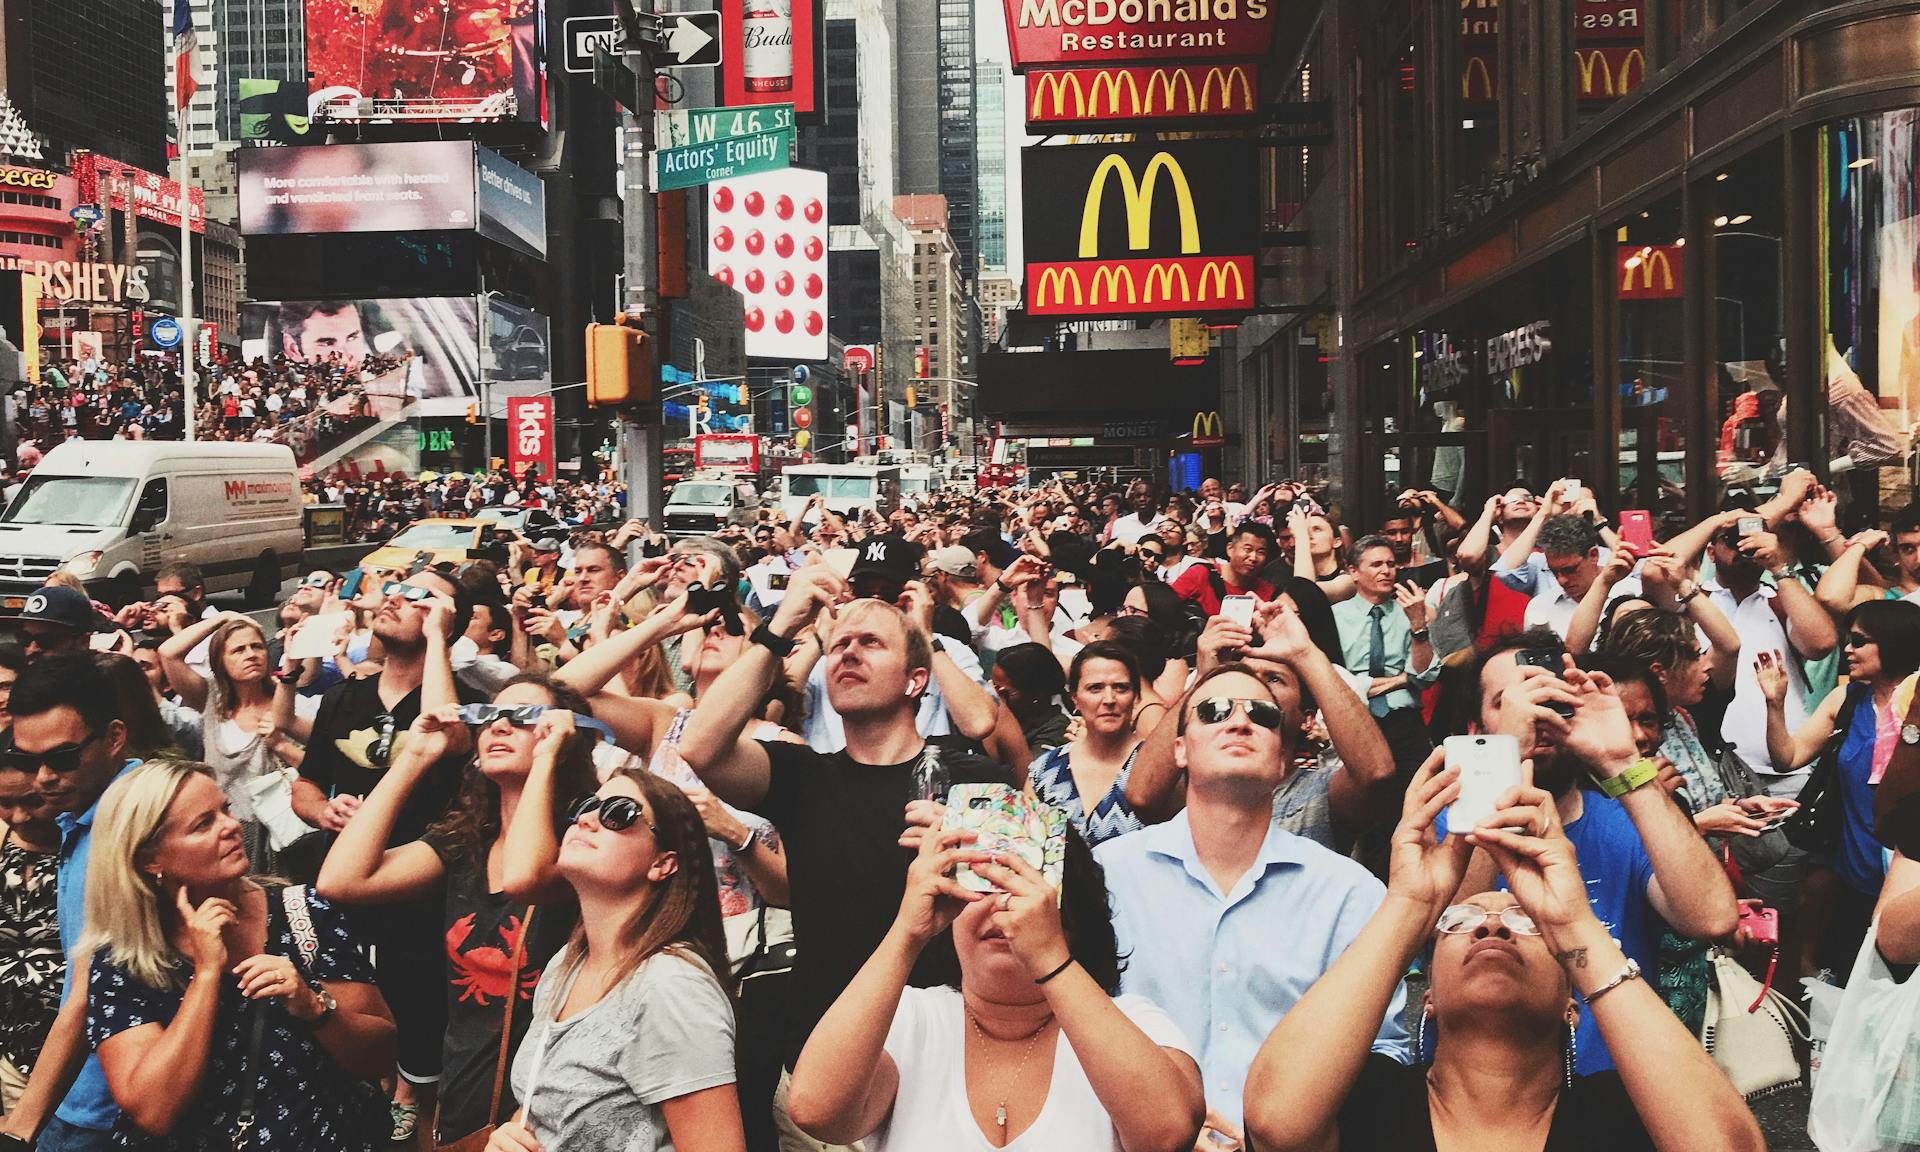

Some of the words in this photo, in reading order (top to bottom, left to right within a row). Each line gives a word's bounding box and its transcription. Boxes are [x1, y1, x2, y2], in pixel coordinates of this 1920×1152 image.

[1018, 0, 1268, 28] McDonald's
[1061, 28, 1227, 51] Restaurant
[694, 114, 717, 143] W
[730, 110, 762, 136] 46
[774, 109, 791, 128] St
[665, 143, 719, 173] Actors'
[726, 134, 778, 165] Equity
[264, 177, 296, 189] More
[298, 174, 374, 188] comfortable
[375, 173, 402, 186] with
[404, 172, 448, 184] heated
[482, 164, 504, 191] Better
[705, 165, 734, 179] Corner
[265, 192, 289, 205] and
[290, 191, 353, 204] ventilated
[354, 190, 384, 202] front
[518, 401, 546, 456] tkts
[865, 541, 887, 561] NY
